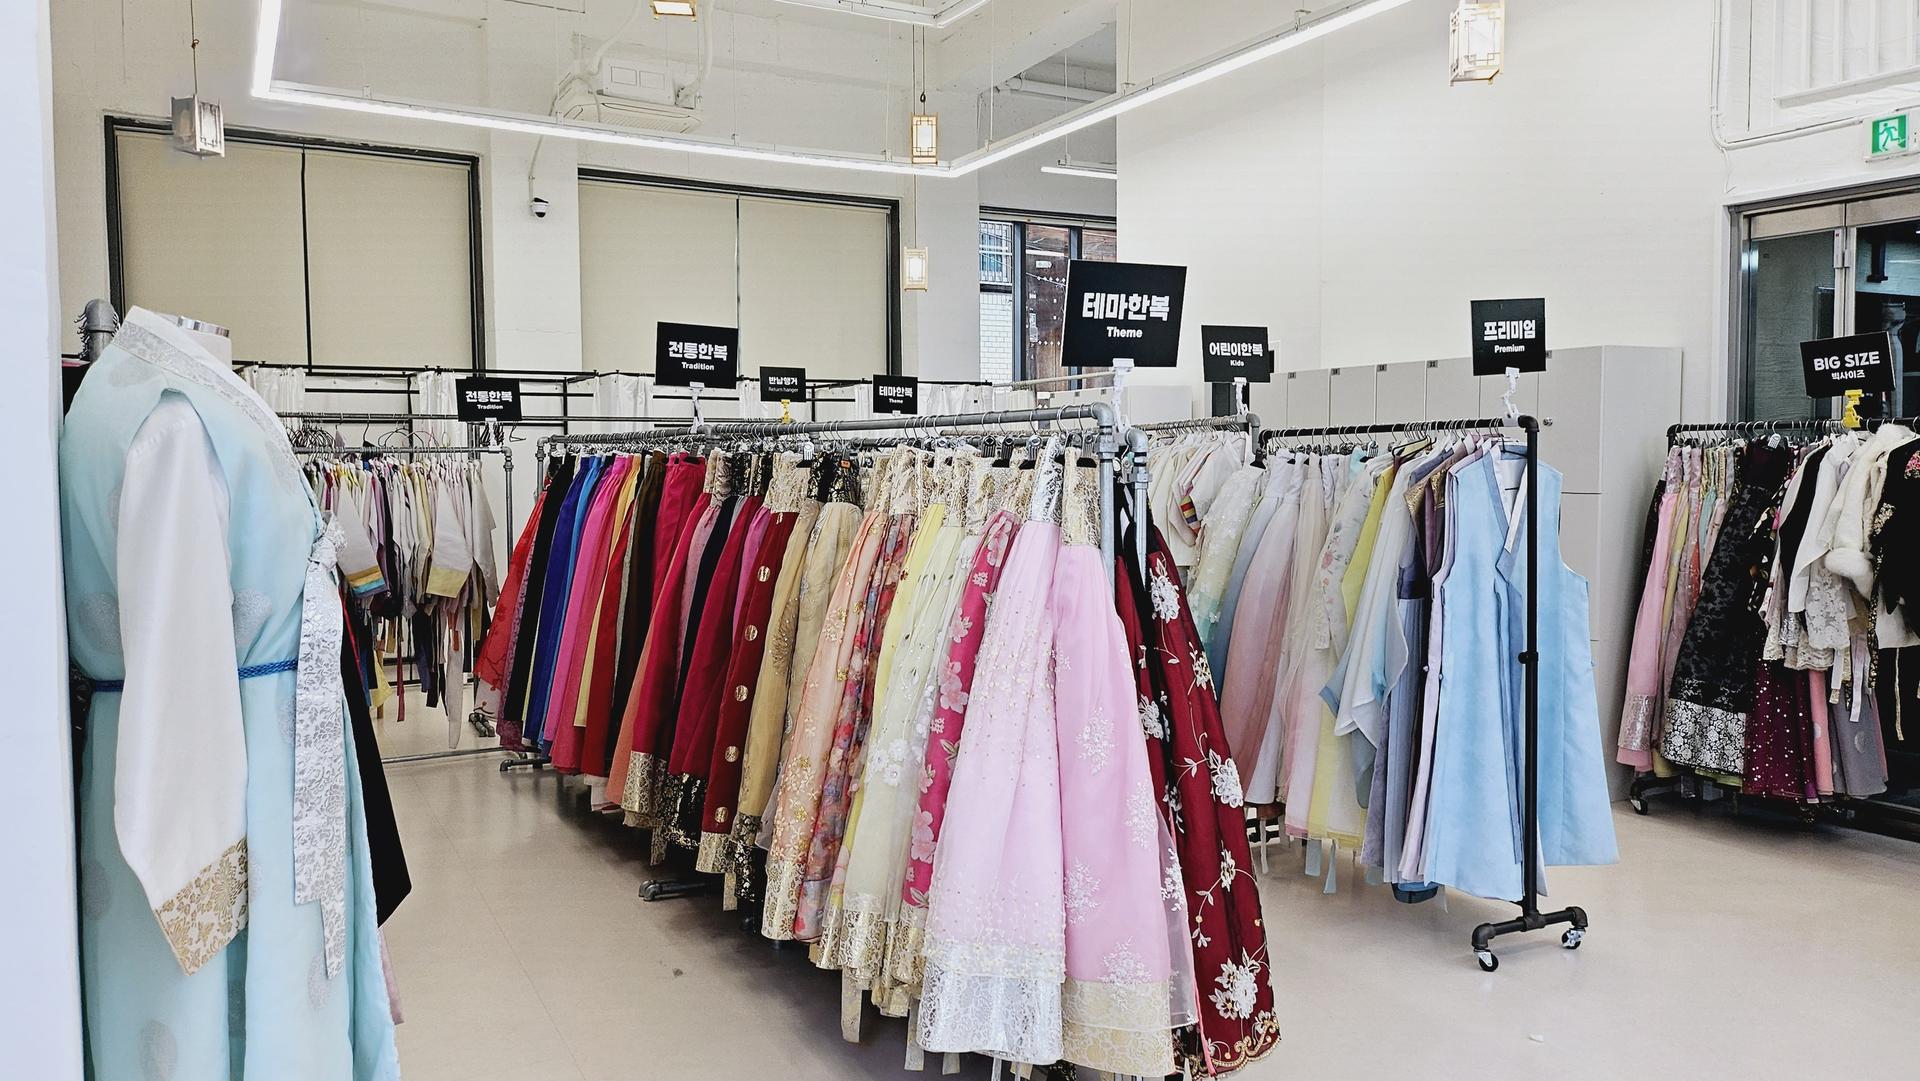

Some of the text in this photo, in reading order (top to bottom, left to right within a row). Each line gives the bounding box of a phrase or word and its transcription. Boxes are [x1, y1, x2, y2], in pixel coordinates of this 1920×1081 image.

[1082, 292, 1170, 321] 테마한복
[1106, 326, 1143, 338] Theme
[1483, 319, 1536, 341] 프리미엄
[668, 341, 728, 361] 전통한복
[1209, 342, 1263, 357] 어린이한복
[1494, 344, 1525, 353] Premium
[681, 361, 715, 371] Tradition
[1813, 350, 1880, 371] BIG SIZE
[1831, 369, 1866, 380] 빅사이즈
[465, 390, 512, 402] 전통한복
[879, 386, 913, 397] 테마한복
